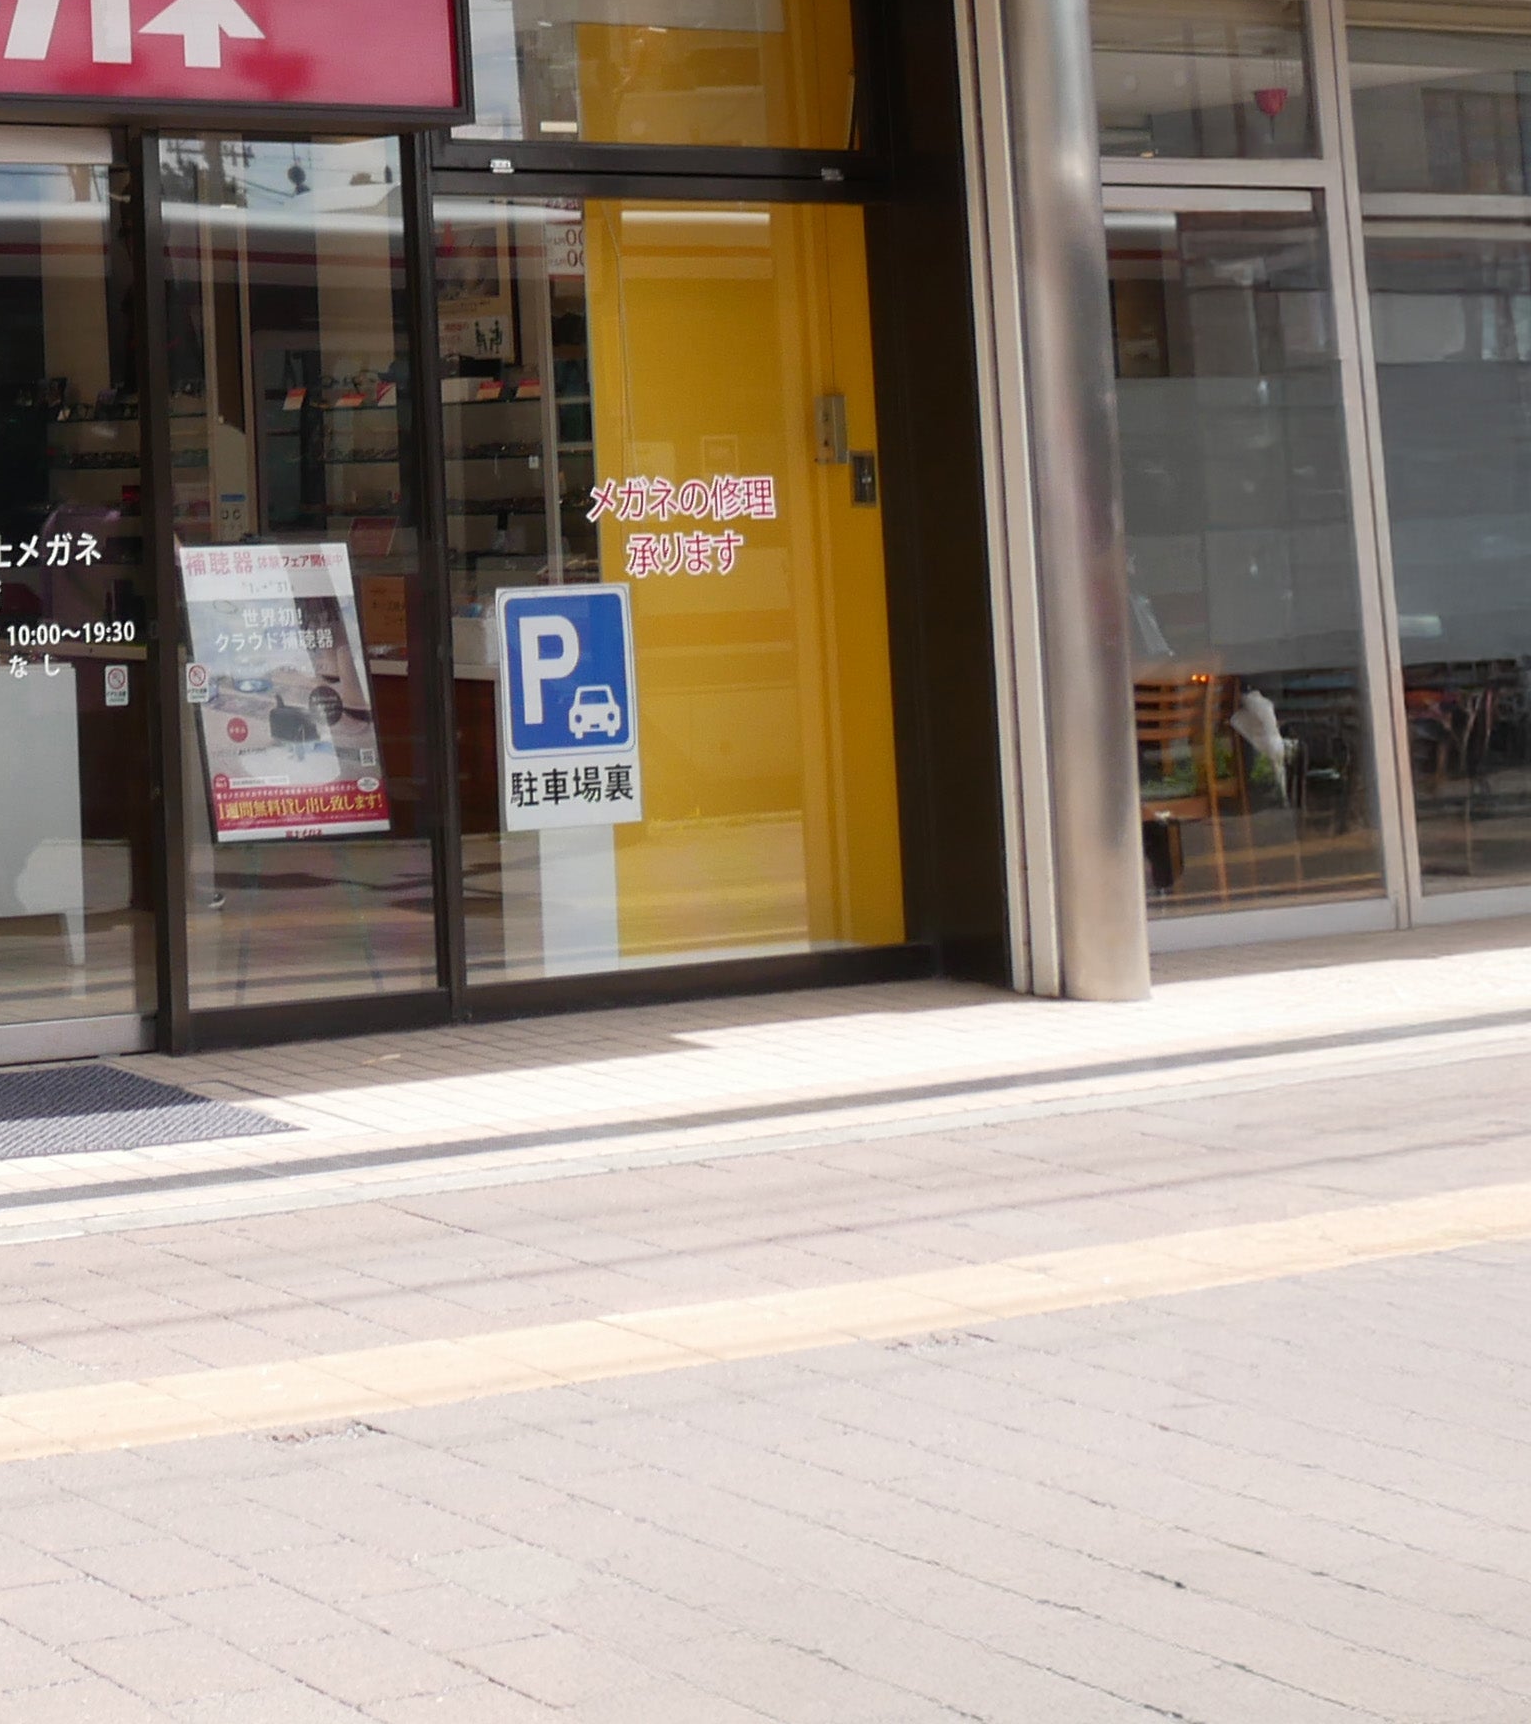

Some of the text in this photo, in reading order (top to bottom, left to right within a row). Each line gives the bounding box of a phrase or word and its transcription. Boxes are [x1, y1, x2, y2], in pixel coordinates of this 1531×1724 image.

[585, 474, 777, 522] メガネの修理
[185, 551, 253, 577] 補聴器
[626, 530, 743, 578] 承ります
[215, 628, 334, 653] クラウド補聴器
[519, 615, 580, 725] P
[510, 763, 635, 807] 駐車場裏
